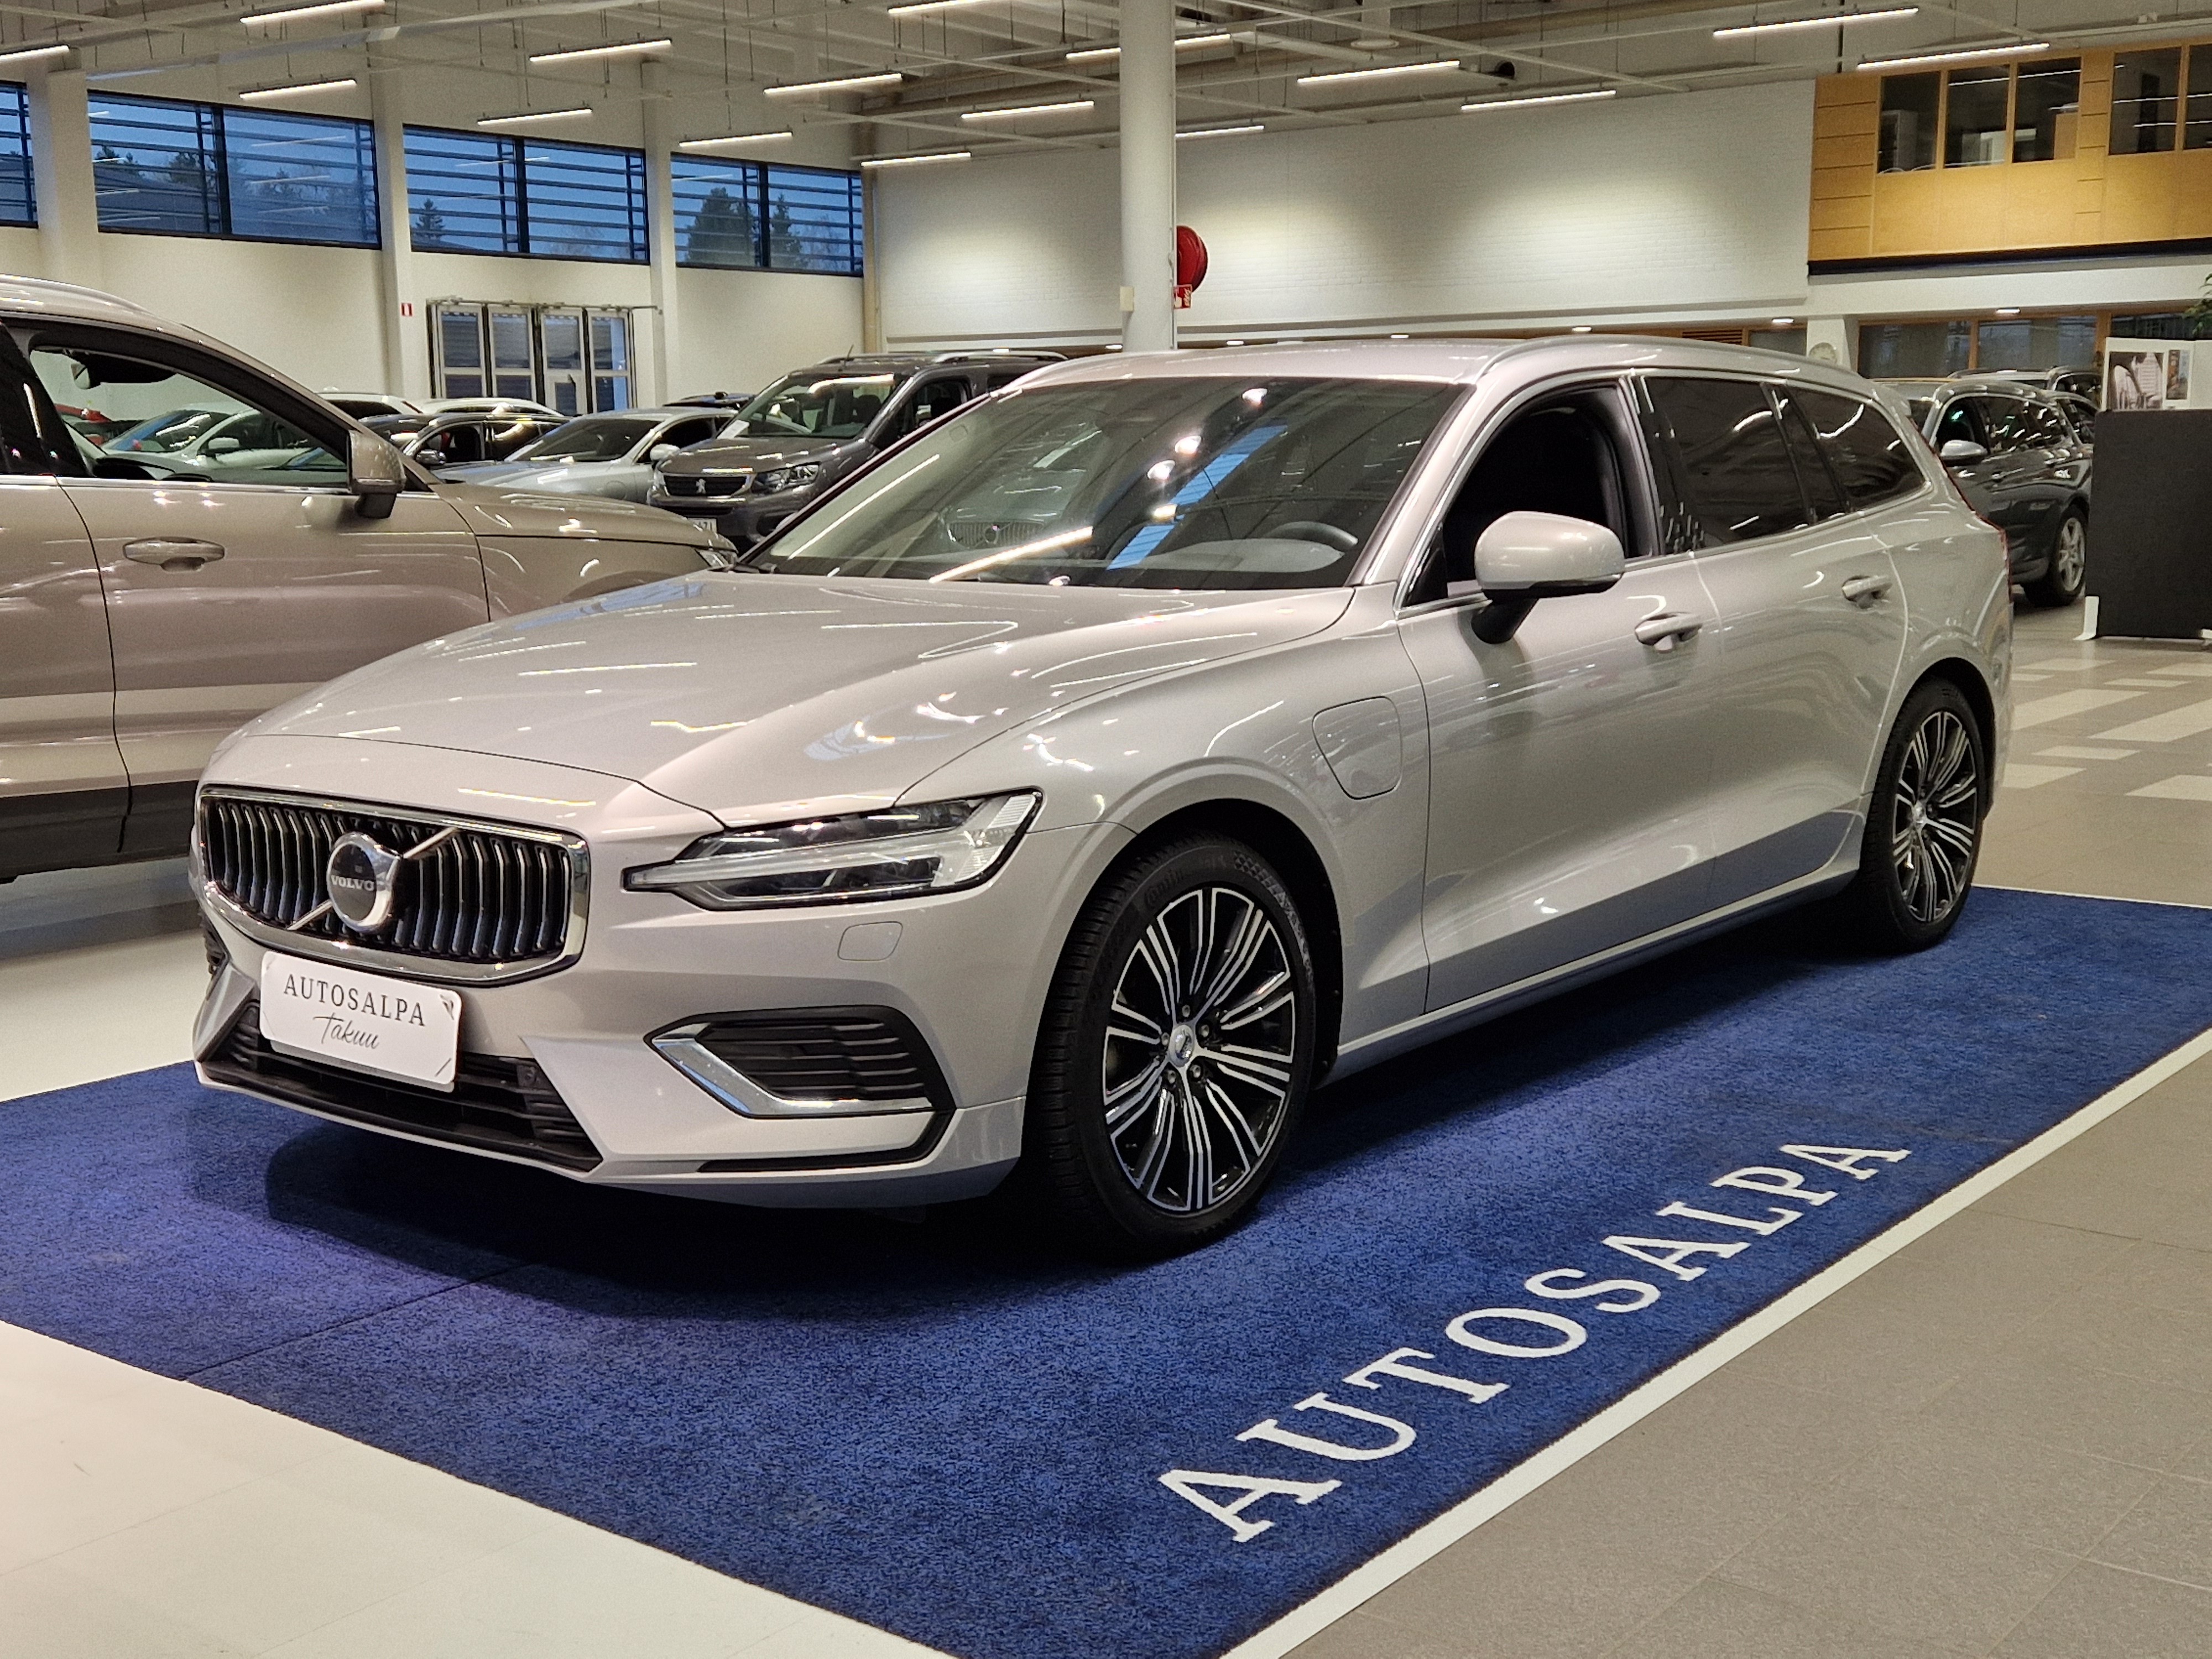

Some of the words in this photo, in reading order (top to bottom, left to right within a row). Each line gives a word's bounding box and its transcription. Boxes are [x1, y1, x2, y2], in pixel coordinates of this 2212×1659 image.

[331, 875, 374, 891] VOLVO
[283, 974, 425, 1026] AUTOSALPA
[313, 1013, 380, 1049] Takuu
[1159, 1143, 1911, 1543] AUTOSALPA
